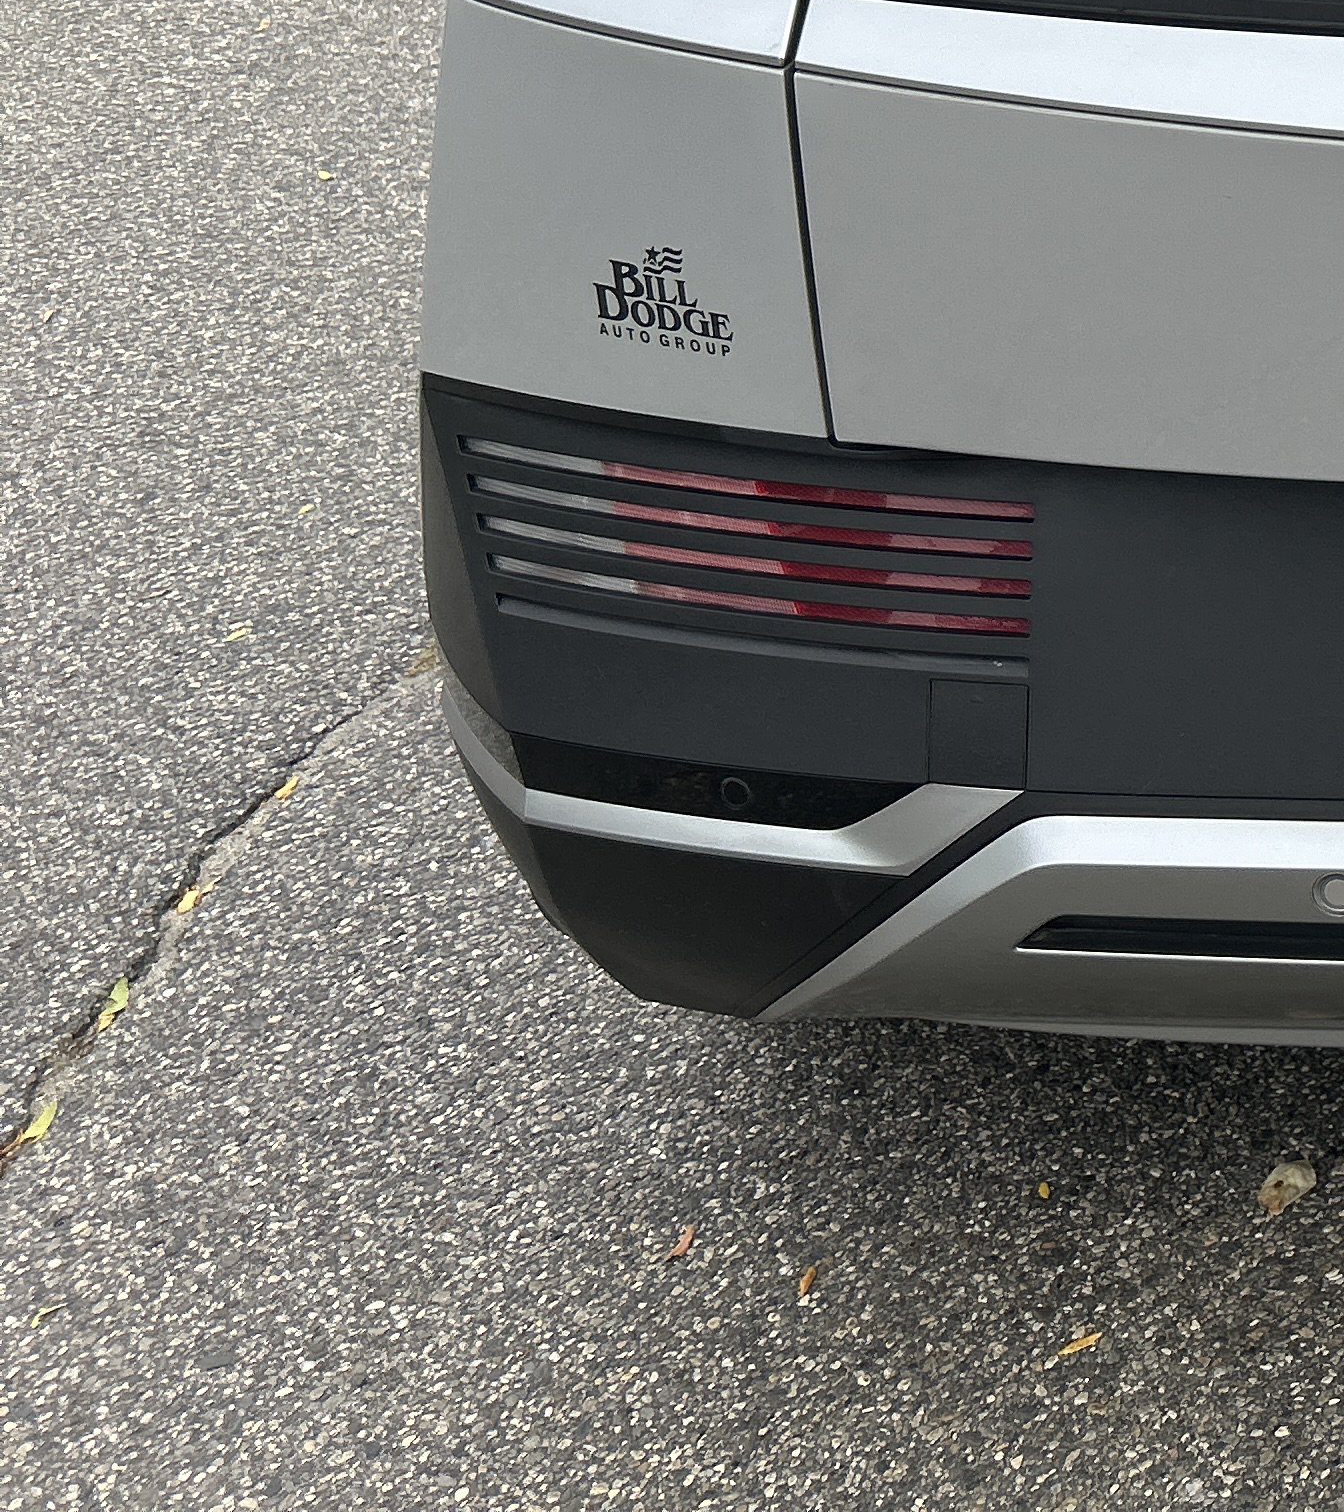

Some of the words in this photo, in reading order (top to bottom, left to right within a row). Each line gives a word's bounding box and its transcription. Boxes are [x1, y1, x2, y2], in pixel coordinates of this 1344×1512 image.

[608, 259, 699, 308] BILL
[592, 282, 735, 341] DODGE
[599, 322, 652, 344] AUTO
[659, 333, 731, 356] GROUP
